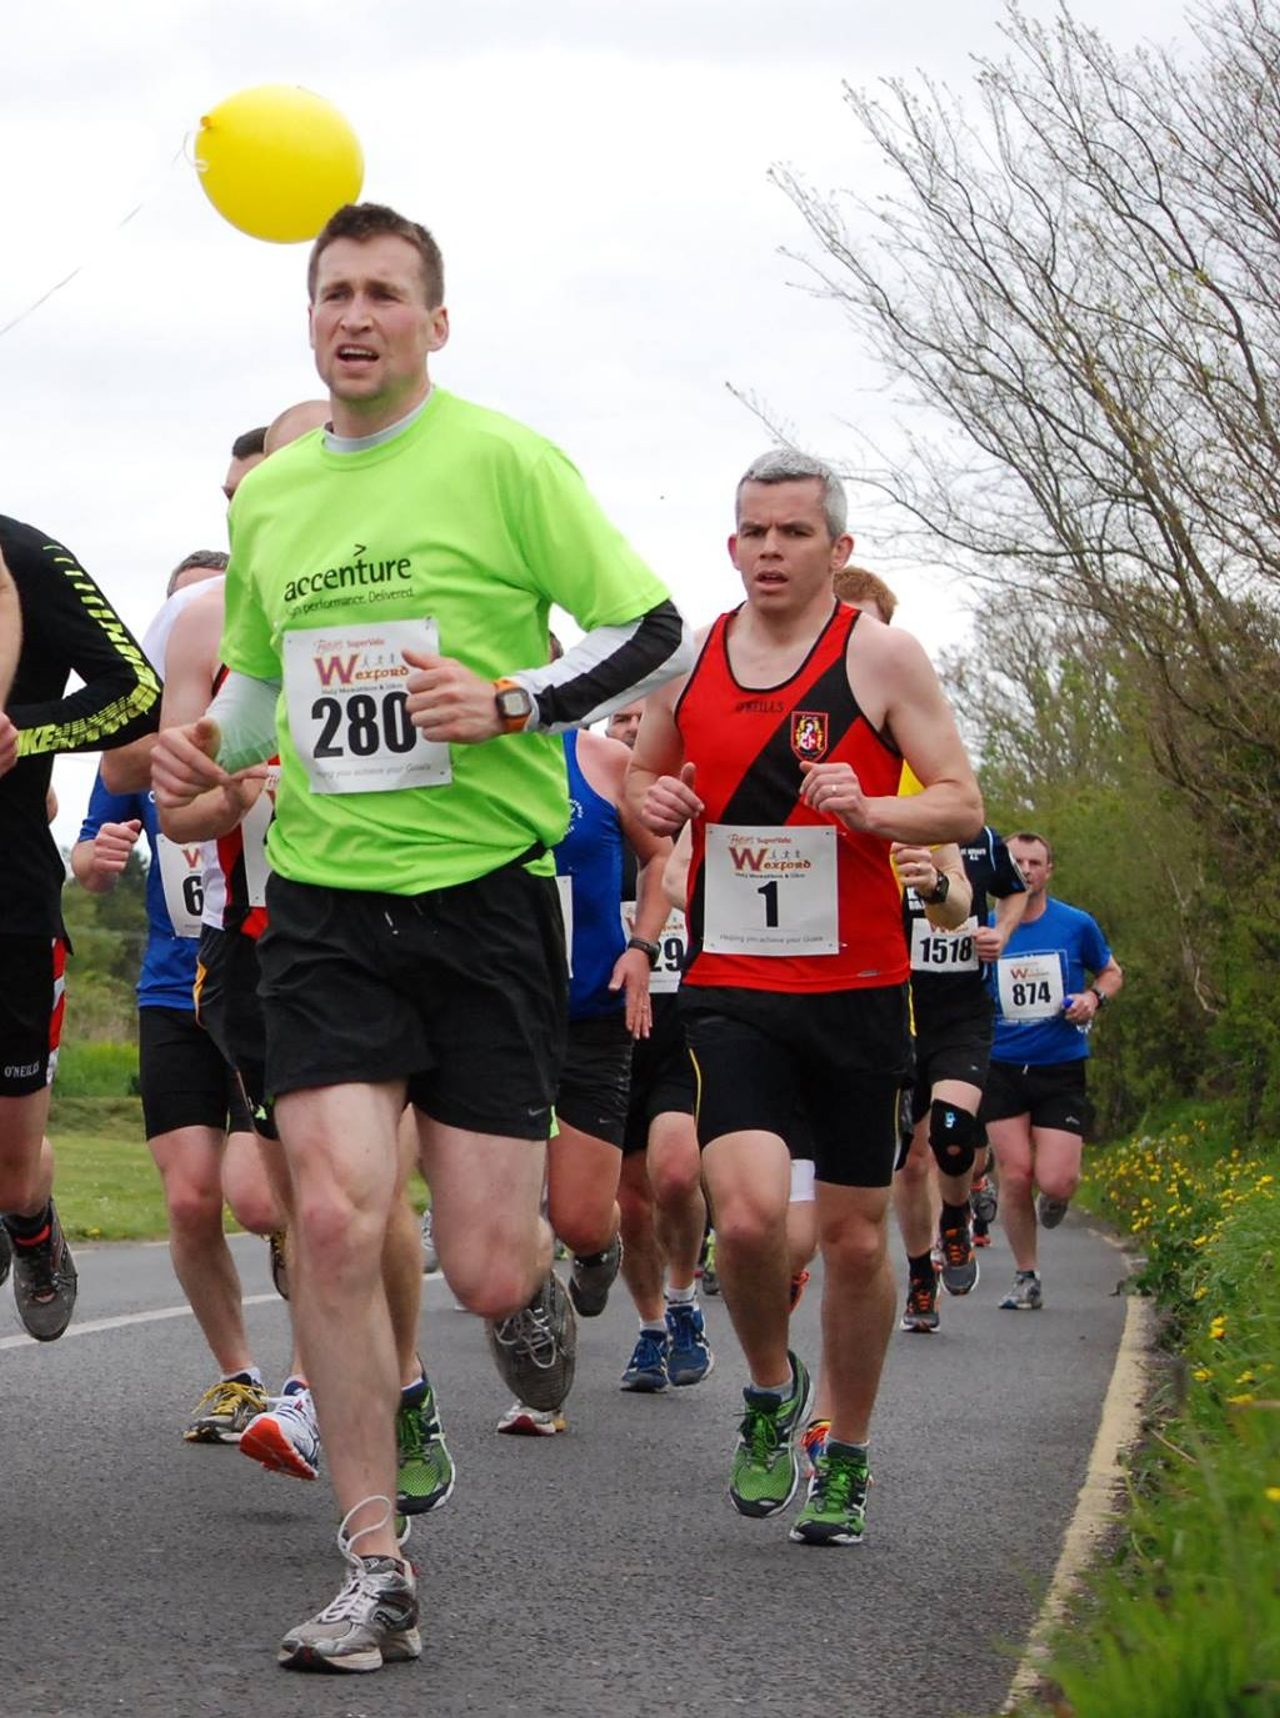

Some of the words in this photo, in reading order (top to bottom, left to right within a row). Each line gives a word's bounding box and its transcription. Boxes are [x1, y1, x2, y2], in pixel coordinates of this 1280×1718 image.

[284, 557, 412, 602] accenture
[311, 692, 417, 759] 280
[729, 846, 812, 872] Wexford
[757, 880, 780, 927] 1
[920, 936, 973, 964] 1518
[1012, 981, 1051, 1007] 874
